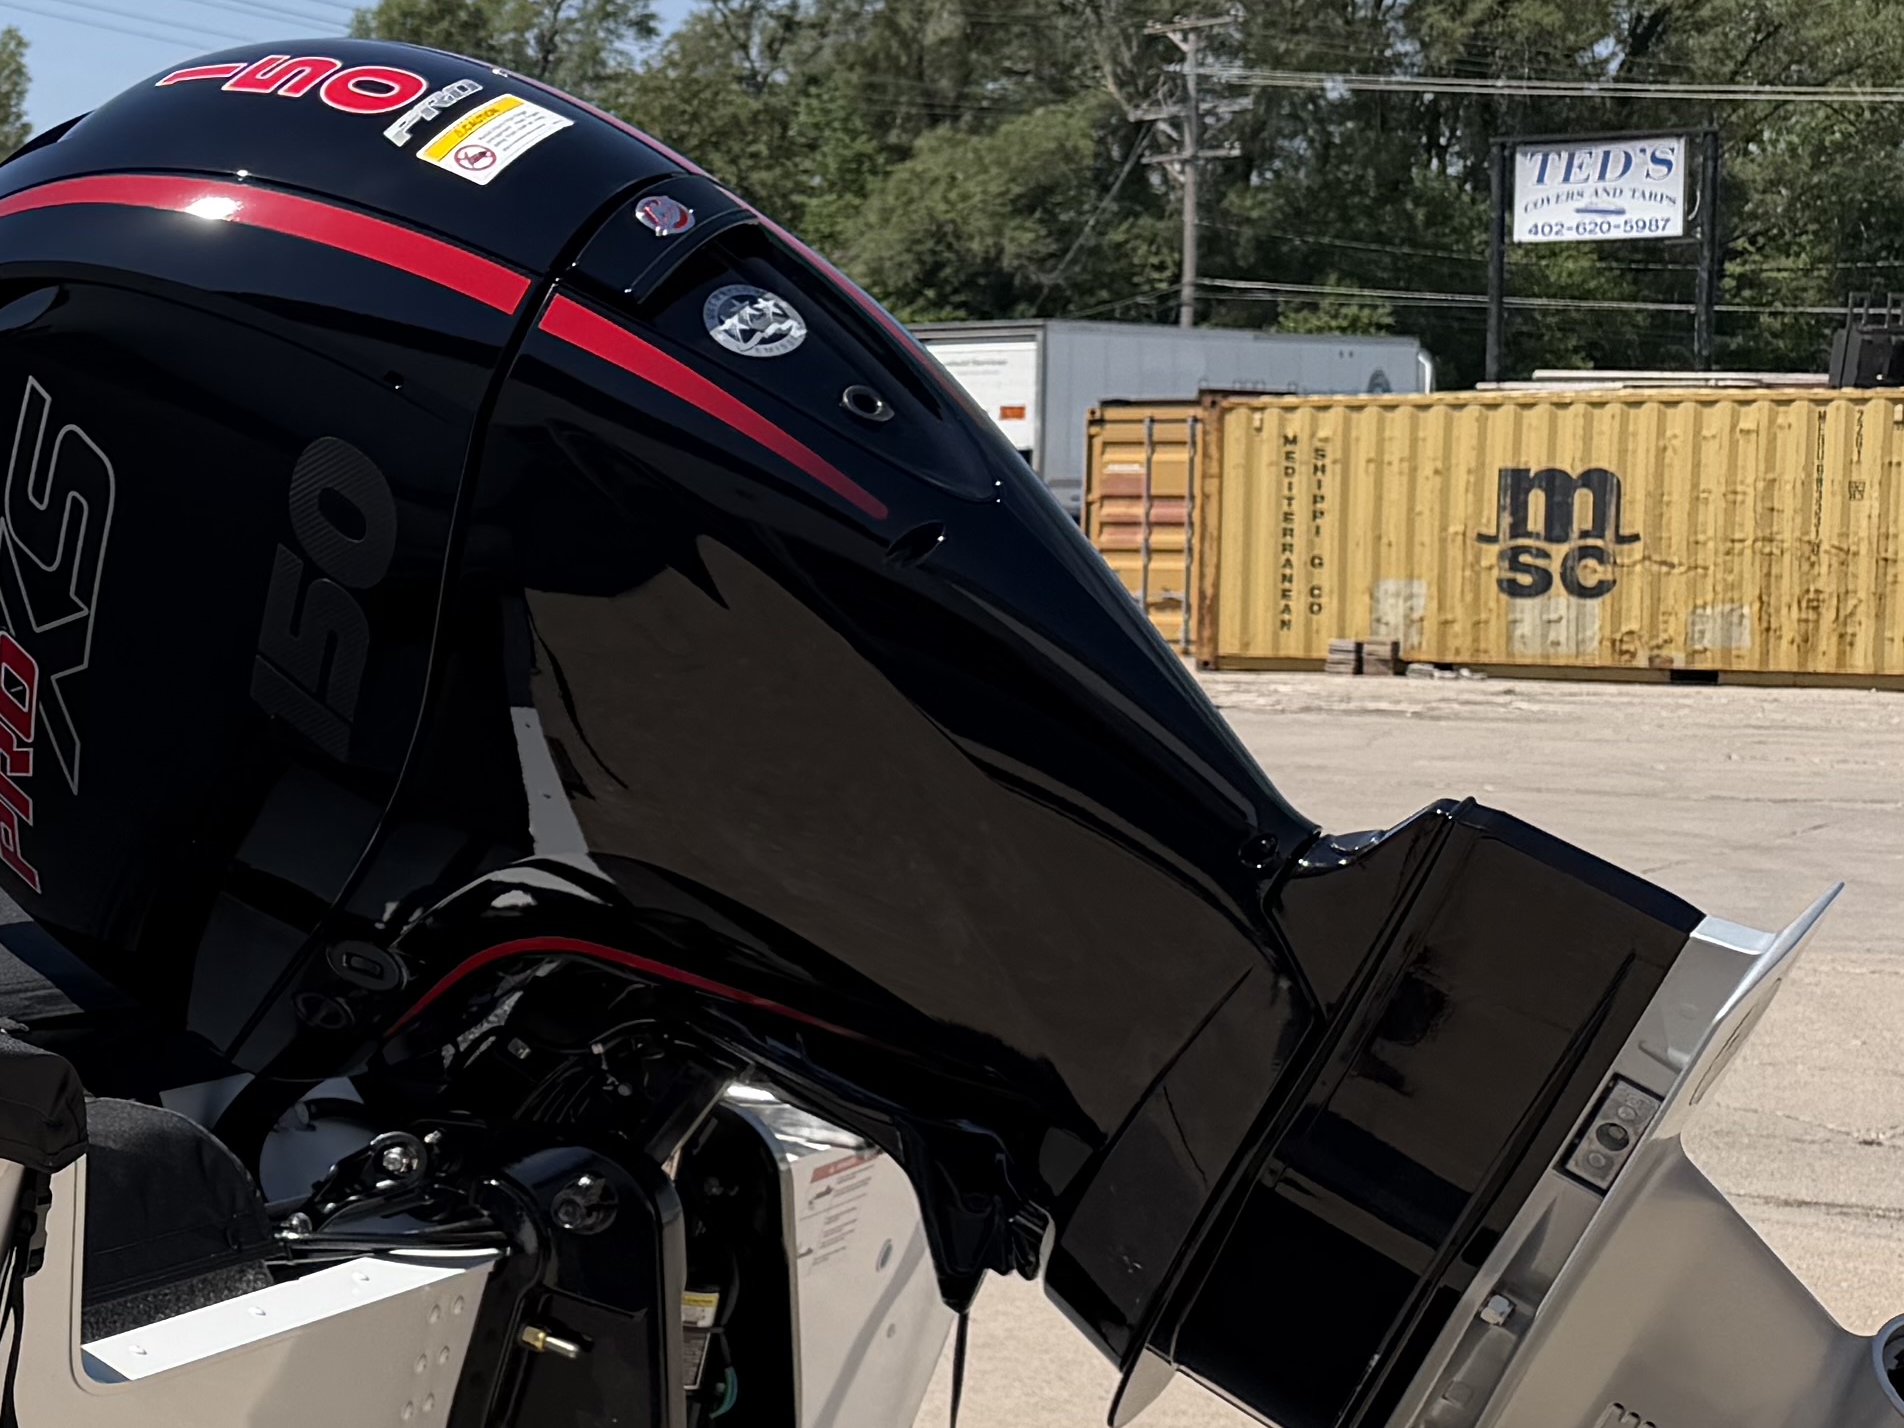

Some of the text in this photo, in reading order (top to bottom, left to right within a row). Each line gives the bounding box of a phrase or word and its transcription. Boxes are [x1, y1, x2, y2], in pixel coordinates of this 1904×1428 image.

[1524, 187, 1677, 214] COVERS AND TARPS
[1528, 146, 1675, 186] TED'S
[1528, 217, 1671, 236] 402-620-5987
[1280, 434, 1298, 632] MEDITERRANEAN
[1310, 448, 1326, 570] SHIPPIG
[250, 436, 397, 763] 150
